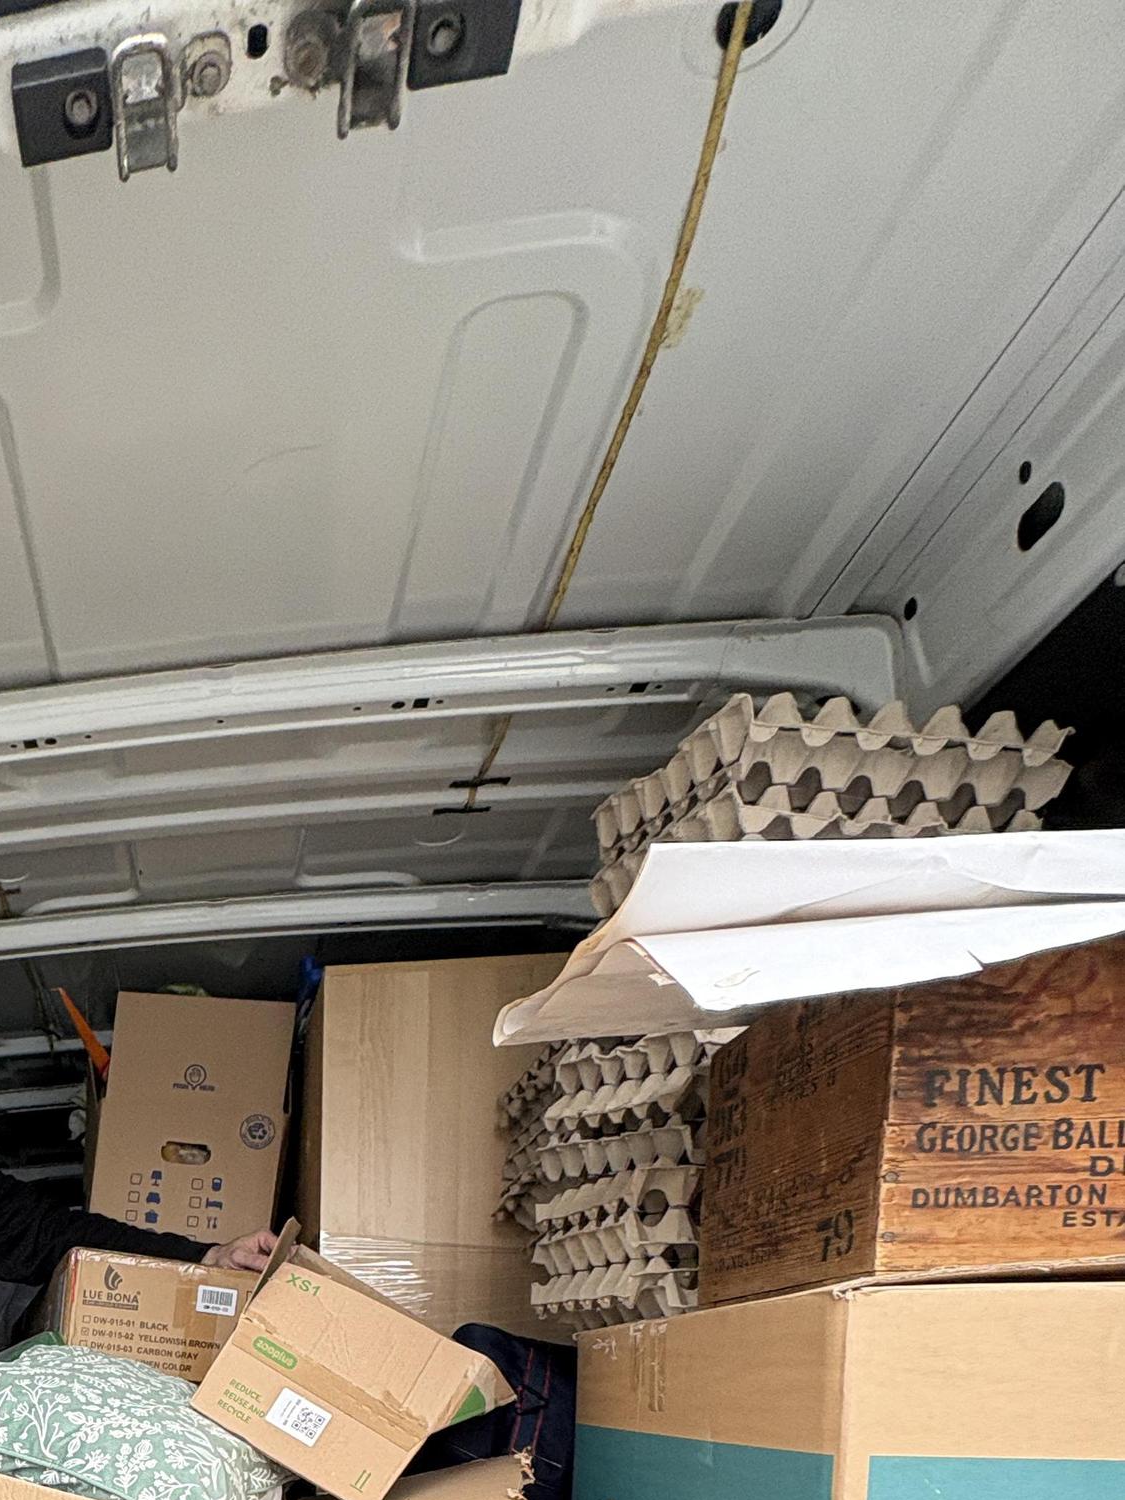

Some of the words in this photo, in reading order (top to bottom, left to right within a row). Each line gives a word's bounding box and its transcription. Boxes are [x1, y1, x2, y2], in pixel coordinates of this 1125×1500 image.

[924, 1064, 1106, 1107] FINEST
[916, 1122, 1042, 1153] GEORGE
[911, 1183, 1107, 1208] DUMBARTON
[83, 1289, 104, 1300] LUE
[107, 1292, 139, 1304] BONA
[286, 1273, 321, 1297] XS1
[139, 1321, 169, 1332] BLACK
[136, 1347, 173, 1359] CARBON
[174, 1351, 199, 1361] GRAY
[138, 1334, 187, 1347] YELLOWISH
[188, 1339, 223, 1350] BROWN
[256, 1338, 295, 1367] zooplus
[162, 1362, 193, 1373] COLOR
[217, 1398, 252, 1424] RECYCLE
[223, 1388, 250, 1409] REUSE
[248, 1404, 265, 1418] AND
